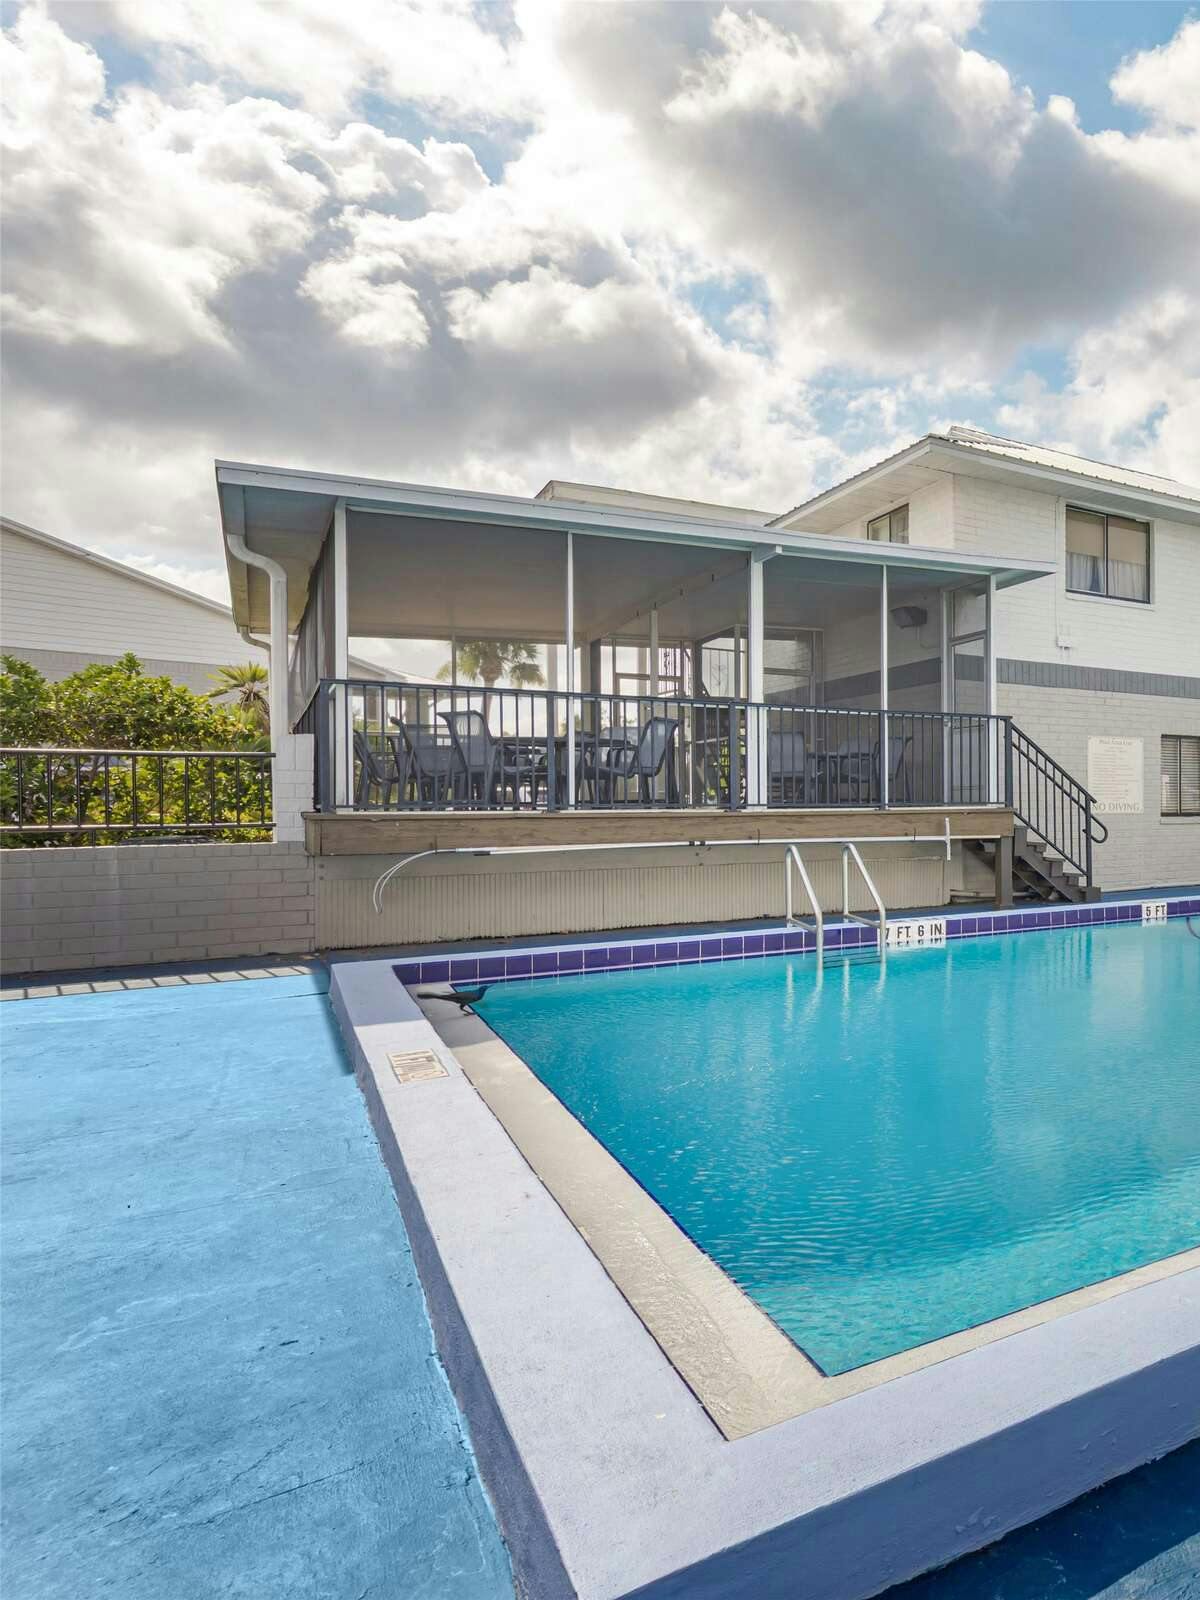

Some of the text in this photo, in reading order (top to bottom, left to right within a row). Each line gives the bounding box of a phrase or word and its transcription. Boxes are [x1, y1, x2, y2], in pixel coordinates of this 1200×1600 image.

[1092, 801, 1140, 811] NO DIVING
[1146, 906, 1151, 917] 5
[917, 924, 925, 937] 6
